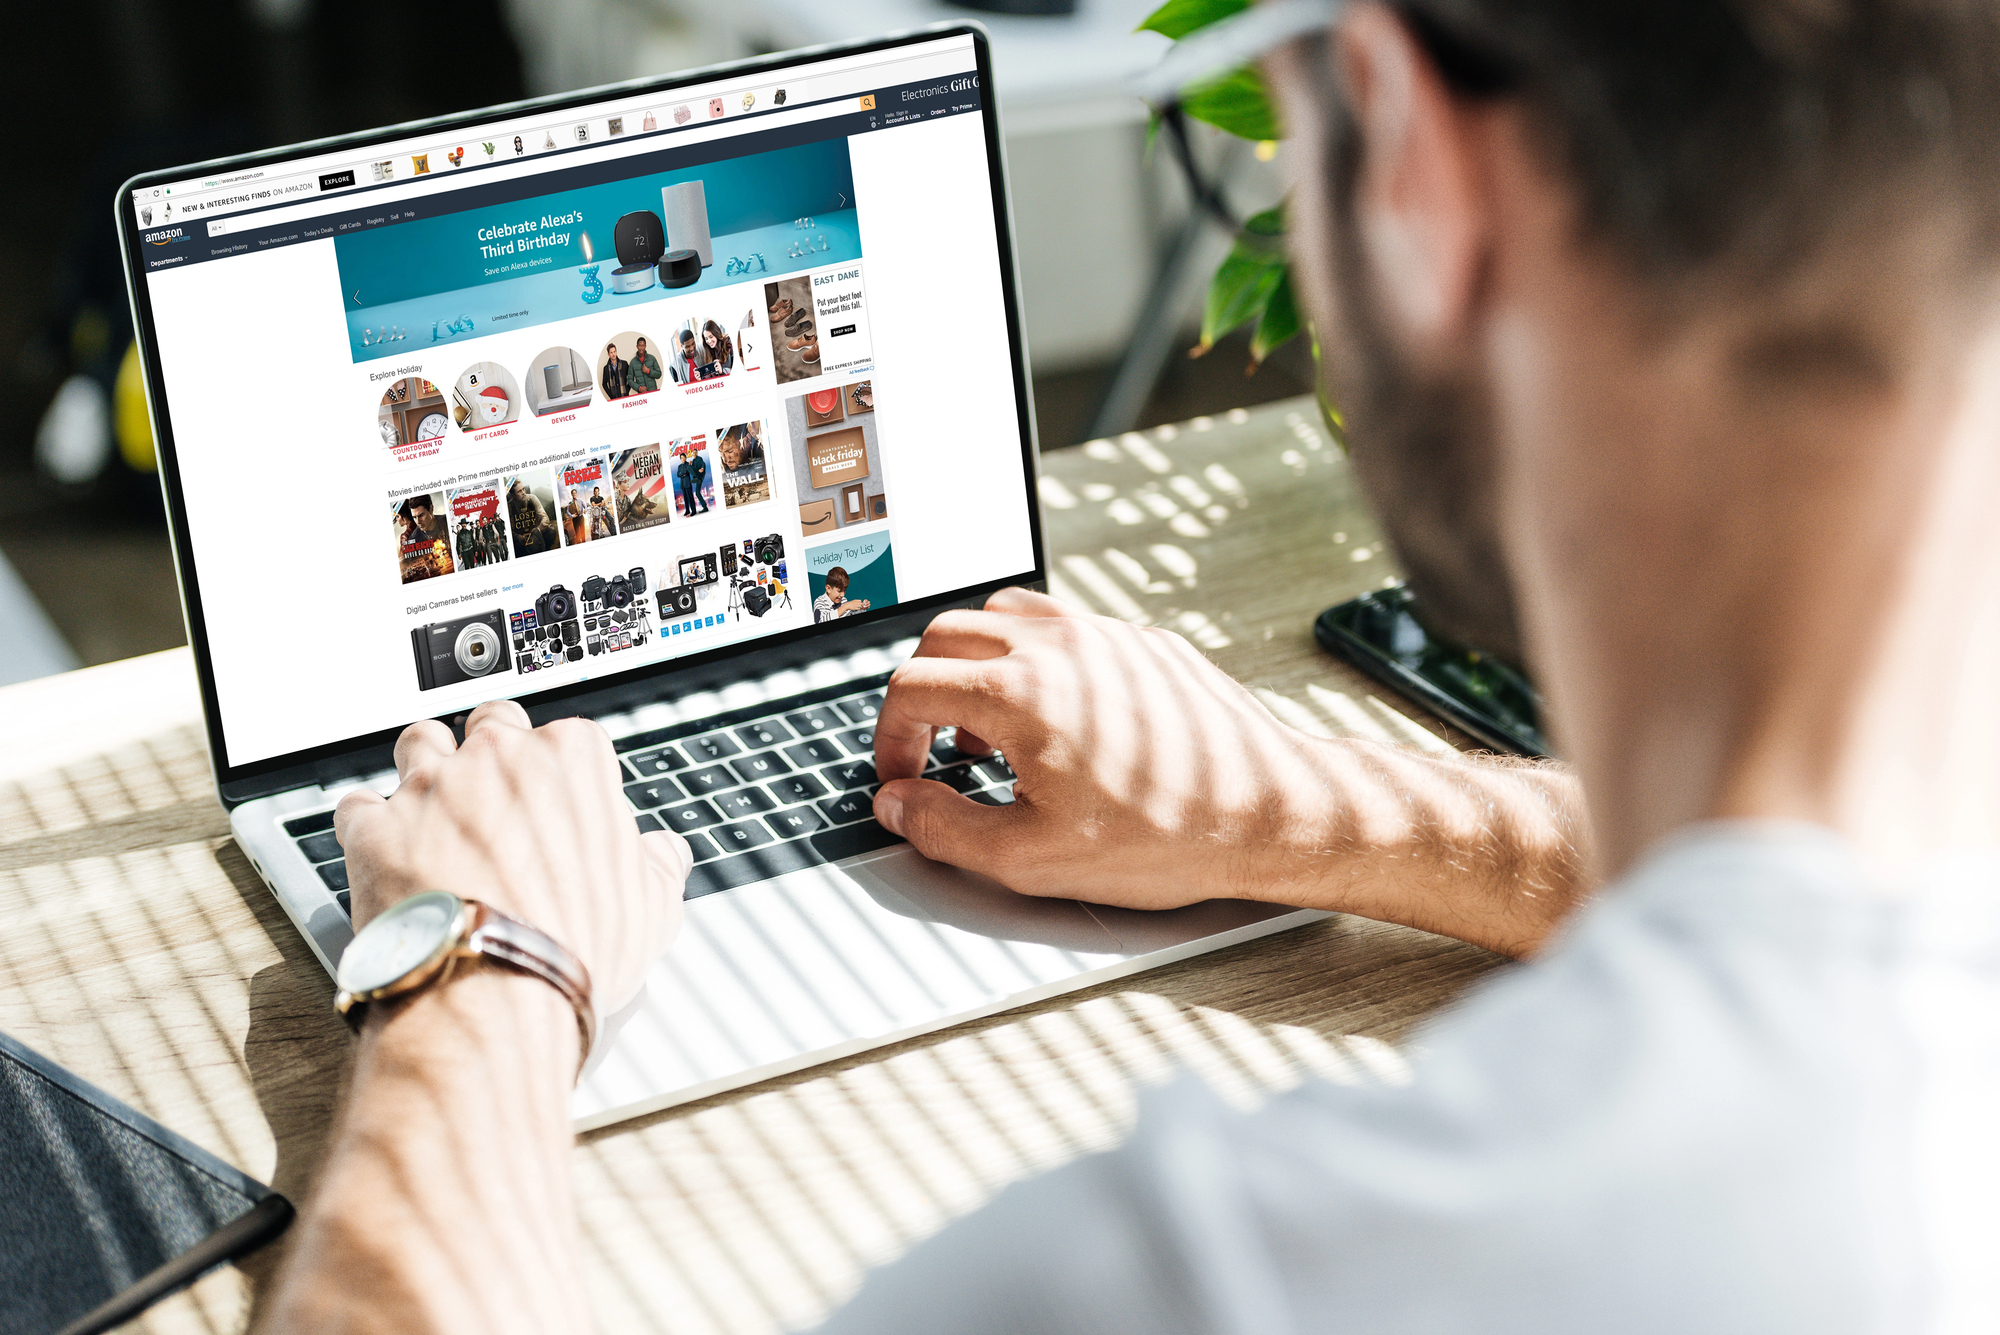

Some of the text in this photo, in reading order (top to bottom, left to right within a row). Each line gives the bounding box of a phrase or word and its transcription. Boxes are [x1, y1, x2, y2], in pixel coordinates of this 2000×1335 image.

[901, 84, 948, 102] Electronics
[950, 78, 971, 92] Gift
[886, 116, 904, 124] Account
[324, 175, 350, 185] EXPLORE
[182, 204, 198, 213] NEW
[207, 194, 250, 208] INTERESTING
[252, 190, 271, 200] FINDS
[285, 183, 313, 194] AMAZON
[366, 217, 385, 226] Registry
[478, 210, 583, 241] Celebrate Alexa's
[145, 227, 183, 242] amazon
[269, 233, 298, 244] Amazon.com
[480, 232, 570, 259] Third Birthday
[634, 236, 645, 247] 72
[211, 244, 248, 255] Browsing History
[150, 256, 183, 267] Departments
[484, 268, 500, 276] Save
[510, 262, 528, 271] Alexa
[529, 257, 552, 267] devices
[814, 270, 859, 286] EAST DANE
[817, 291, 862, 307] Put your best foot
[820, 305, 840, 316] forward
[840, 303, 850, 311] this
[853, 358, 871, 366] SHIPPING
[370, 364, 423, 382] Explore Holiday
[470, 373, 478, 385] a
[685, 382, 724, 395] VIDEO GAMES
[622, 398, 648, 409] FASHION
[551, 414, 576, 425] DEVICES
[489, 428, 509, 439] CARDS
[392, 442, 433, 456] COUNTDOWN
[672, 441, 707, 457] USH HOUR
[686, 449, 693, 458] 2
[820, 445, 847, 454] COUNTDOWN
[398, 448, 440, 462] BLACK FRIDAY
[812, 448, 864, 466] black friday
[633, 454, 660, 469] MEGAN
[388, 488, 412, 498] Movies
[413, 479, 442, 493] included
[443, 477, 457, 487] with
[458, 473, 478, 483] Prime
[479, 464, 520, 480] membership
[521, 460, 528, 468] at
[539, 451, 571, 466] additional
[571, 448, 586, 458] cost
[564, 465, 601, 478] DADDY'S
[634, 464, 661, 480] LEAVEY
[565, 471, 602, 486] HOME
[727, 472, 764, 488] WALL
[454, 496, 495, 510] MAGNIFICENT
[465, 501, 487, 510] SEVEN
[514, 510, 536, 521] LOST
[515, 518, 536, 529] CITY
[524, 532, 534, 546] Z
[404, 551, 417, 559] NEVER
[813, 544, 874, 565] Holiday Toy List
[406, 588, 498, 615] Digital Cameras best sellers
[858, 734, 872, 744] O
[809, 747, 818, 757] I
[753, 760, 768, 770] U
[700, 774, 712, 784] Y
[843, 769, 857, 779] K
[647, 788, 659, 798] T
[794, 784, 803, 793] J
[736, 796, 752, 807] H
[840, 803, 857, 813] M
[682, 810, 698, 820] G
[788, 816, 803, 826] N
[734, 831, 747, 840] B
